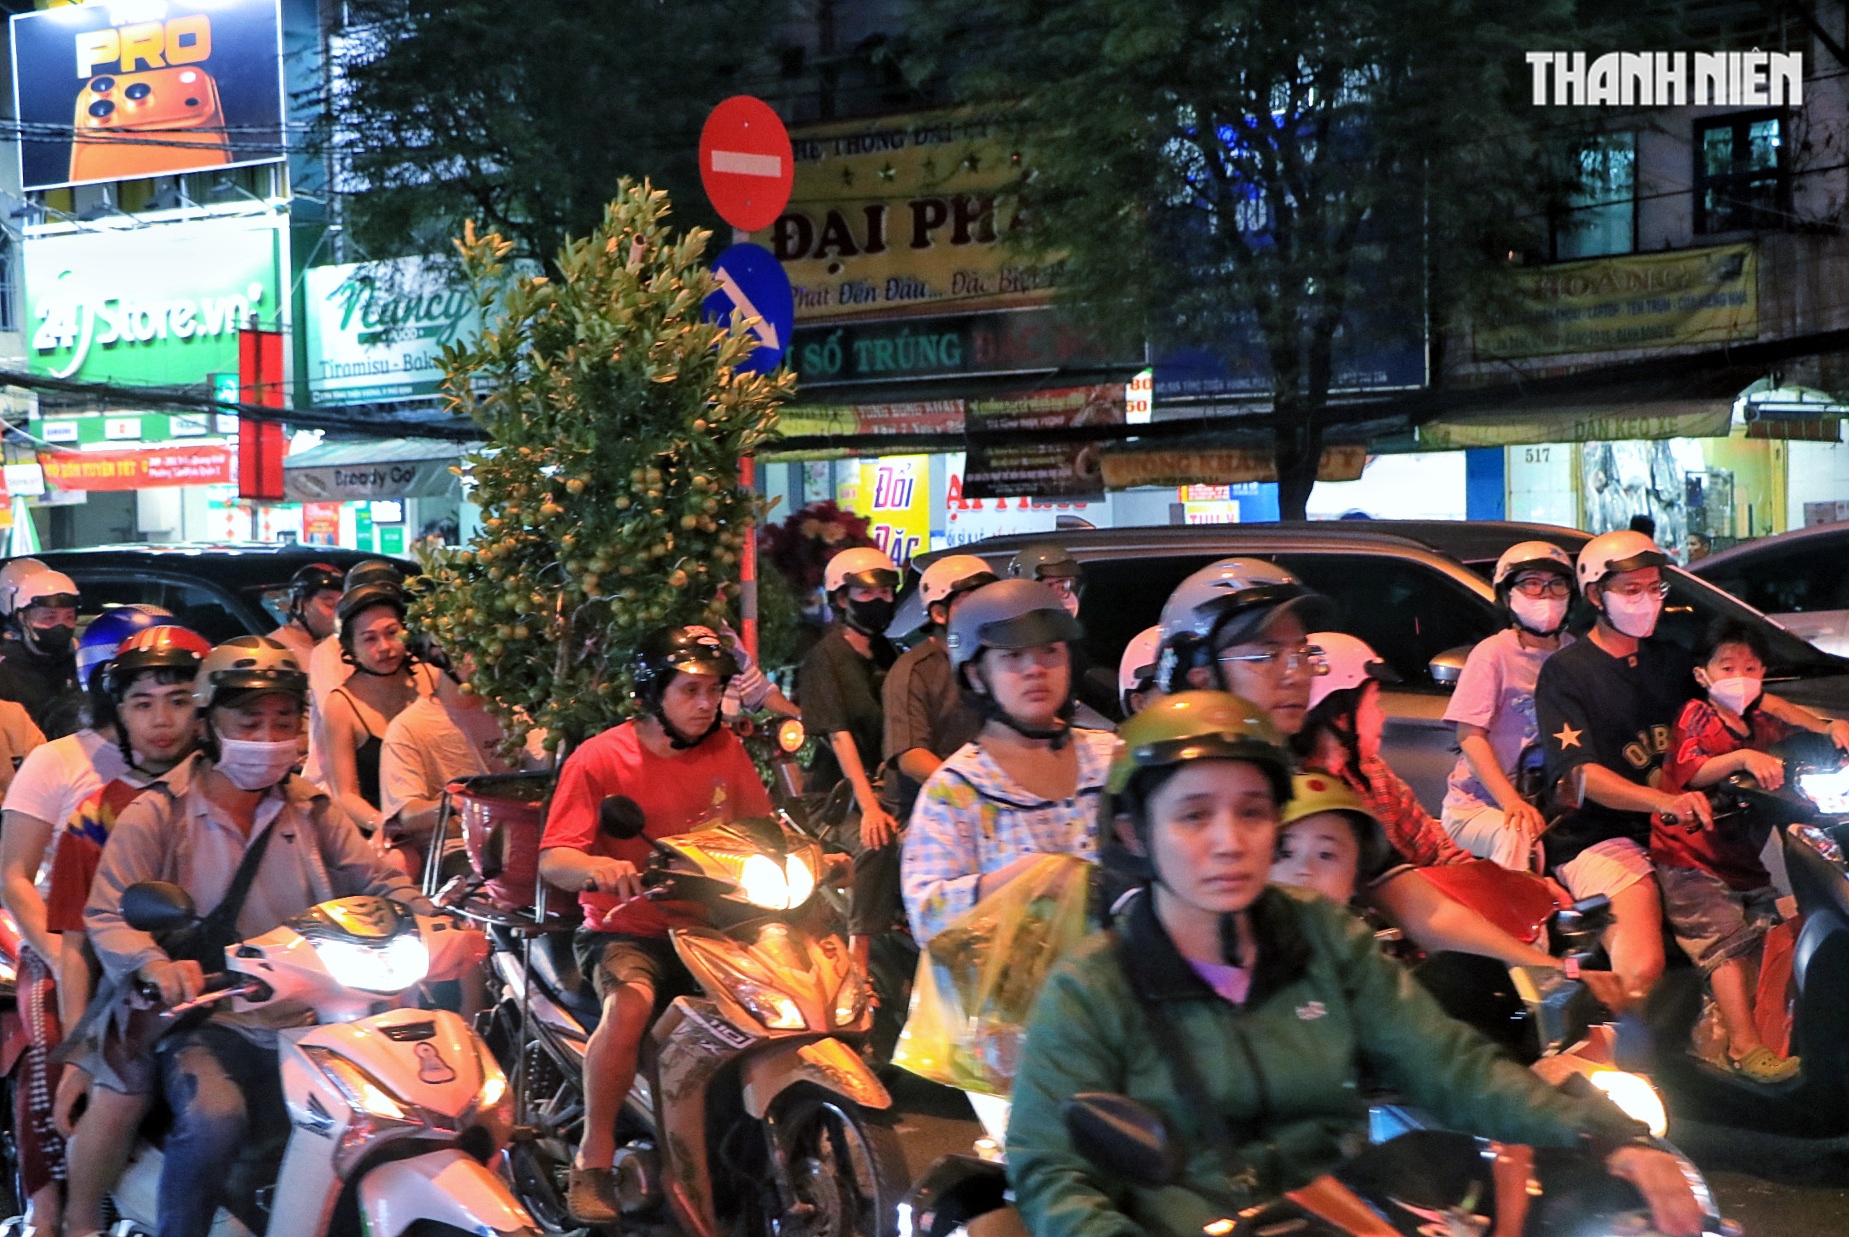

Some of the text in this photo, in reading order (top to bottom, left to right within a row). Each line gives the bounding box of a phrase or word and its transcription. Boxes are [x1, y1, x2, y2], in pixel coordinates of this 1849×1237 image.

[75, 14, 211, 79] PRO
[771, 203, 888, 275] ĐẠI
[327, 276, 471, 346] Nancy
[852, 327, 960, 372] TRÚNG
[1525, 448, 1550, 463] 517
